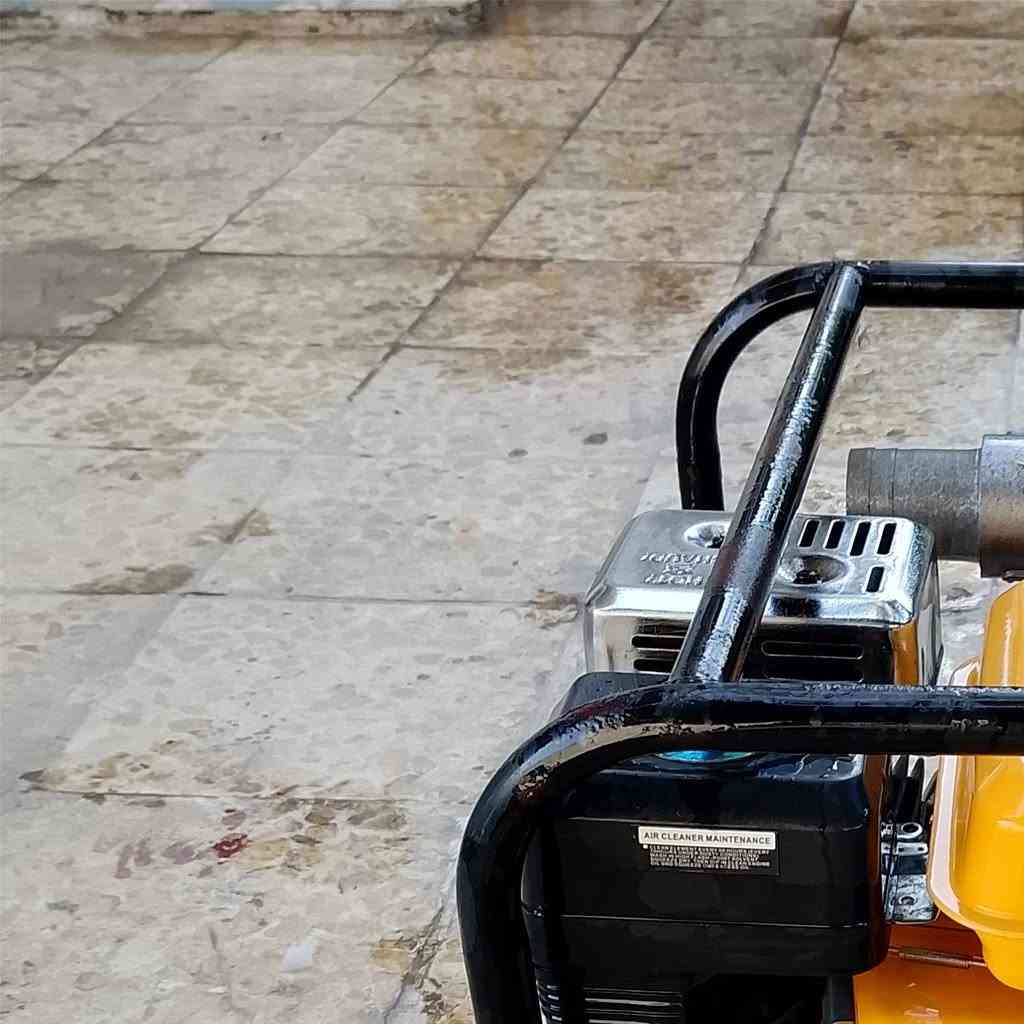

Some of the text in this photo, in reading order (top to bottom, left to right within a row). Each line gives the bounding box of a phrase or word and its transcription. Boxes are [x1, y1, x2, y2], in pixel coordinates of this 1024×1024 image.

[644, 832, 772, 845] AIR CLEANER MAINTENANCE
